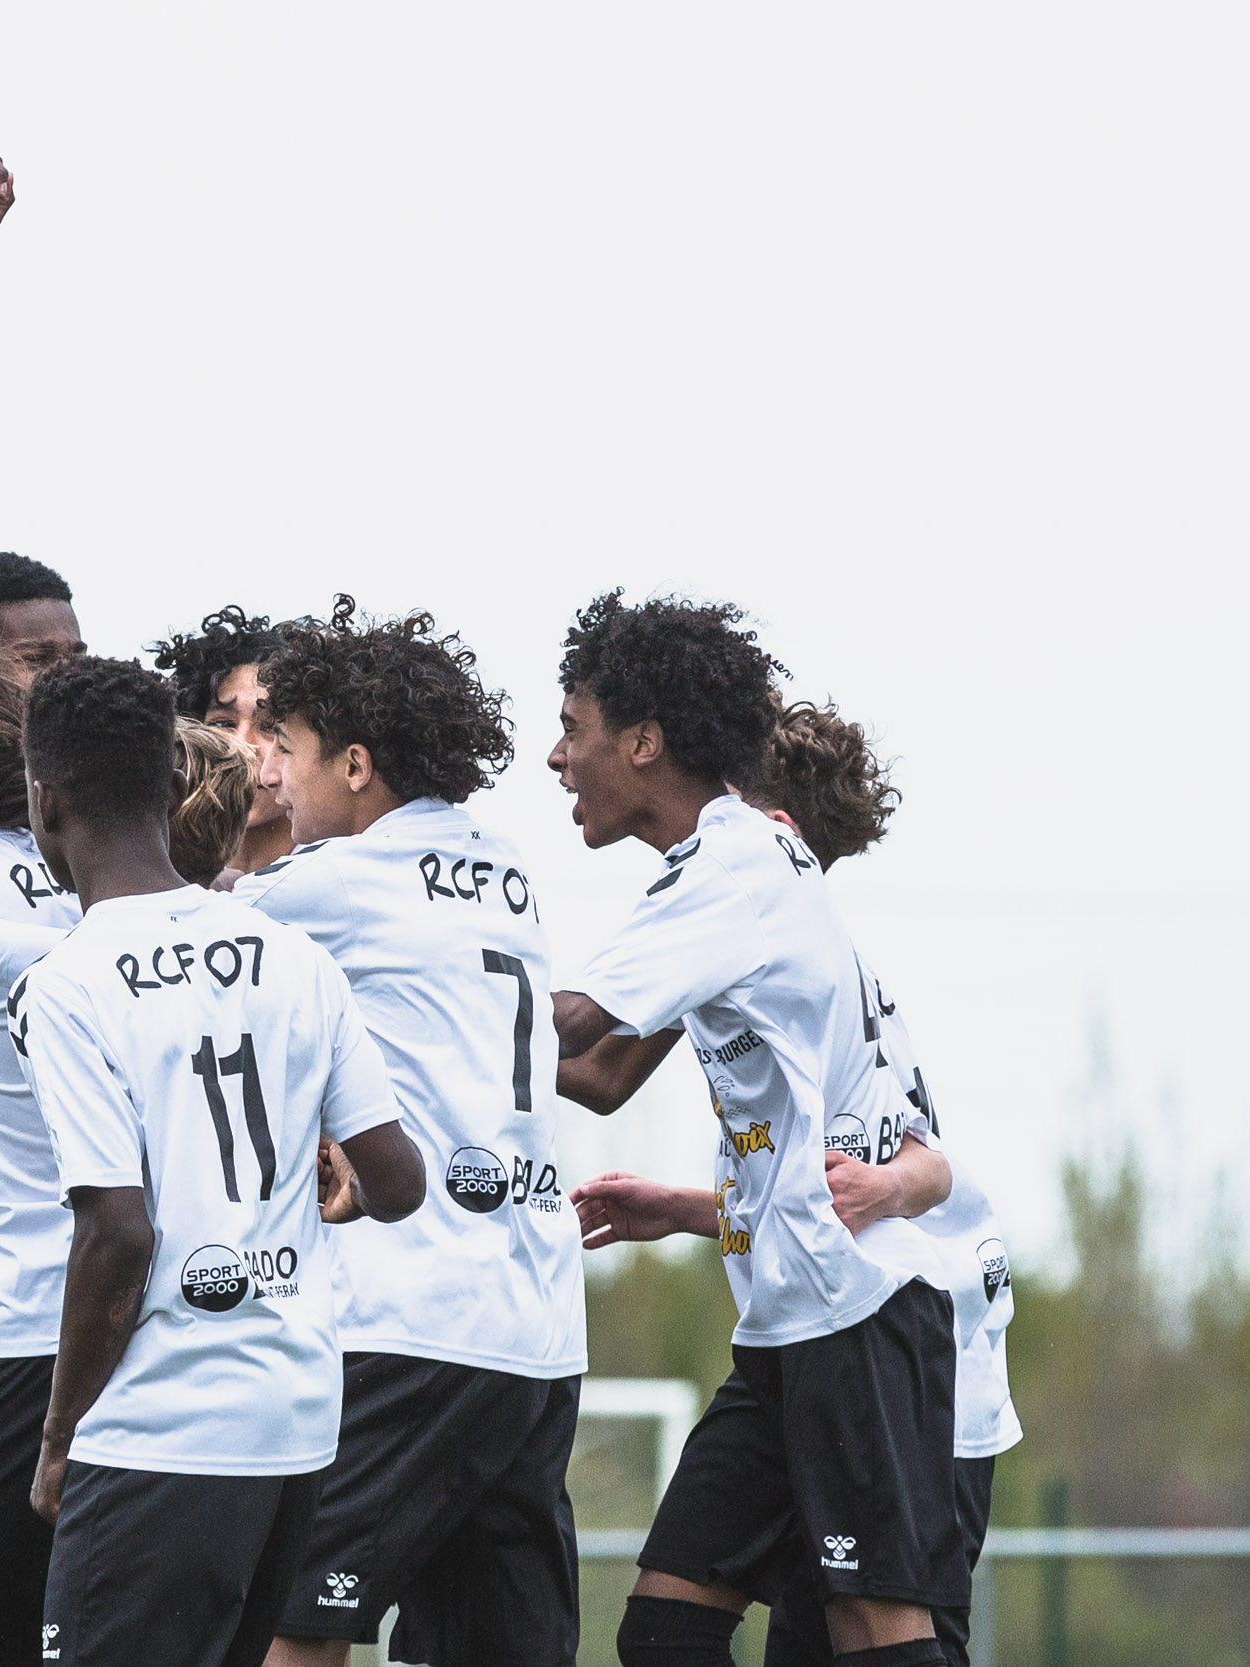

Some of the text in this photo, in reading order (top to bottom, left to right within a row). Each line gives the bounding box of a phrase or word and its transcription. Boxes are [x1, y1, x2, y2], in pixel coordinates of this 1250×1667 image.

[418, 852, 494, 904] RCF
[115, 936, 264, 998] RCF 07
[481, 948, 534, 1113] 7
[191, 1032, 277, 1203] 11
[452, 1166, 501, 1179] SPORT
[456, 1180, 498, 1194] 2000
[186, 1264, 240, 1283] SPORT
[193, 1280, 239, 1297] 2000
[821, 1555, 859, 1570] hummel
[317, 1594, 360, 1608] hummel
